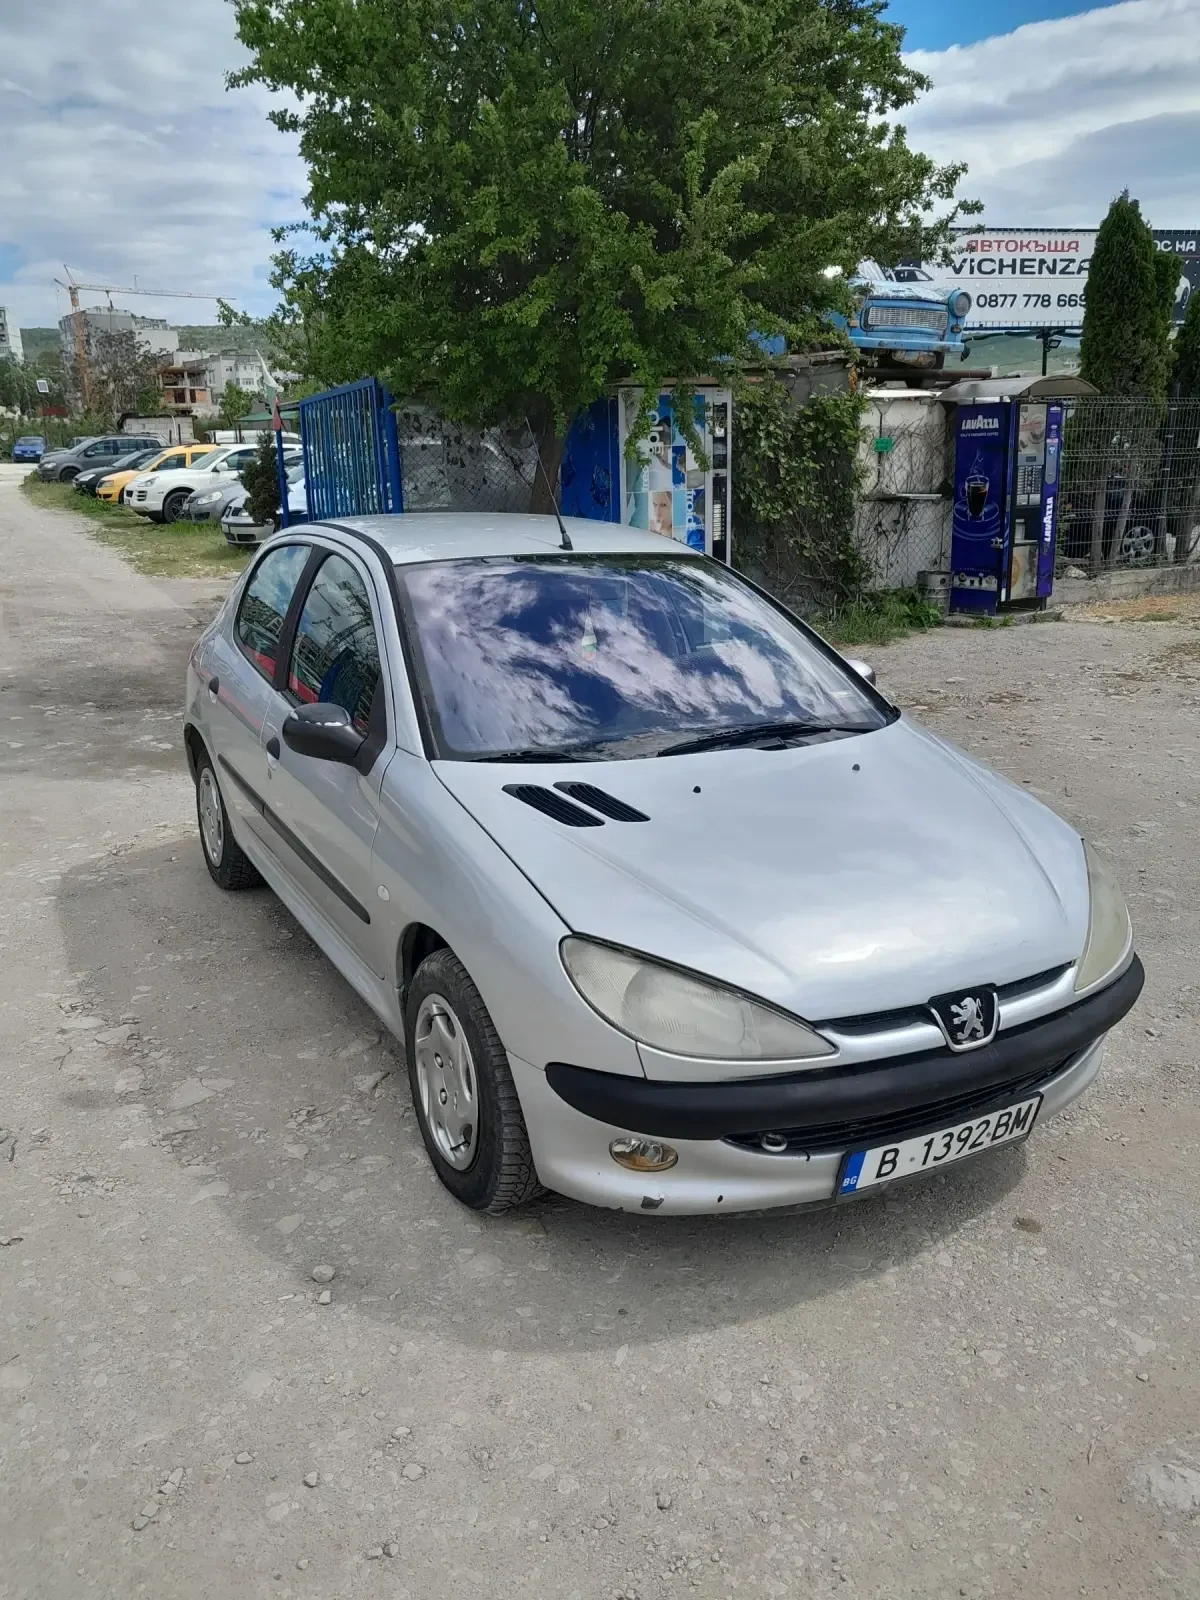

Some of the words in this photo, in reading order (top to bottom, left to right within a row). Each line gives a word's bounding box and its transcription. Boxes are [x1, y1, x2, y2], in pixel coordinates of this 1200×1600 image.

[1175, 240, 1196, 252] НА
[976, 294, 1017, 308] 0877
[1022, 294, 1051, 308] 778
[961, 414, 1000, 430] LAVAZZA
[1043, 496, 1054, 542] LAVAZZA
[875, 1148, 900, 1178] B
[921, 1119, 991, 1166] 1392
[990, 1102, 1033, 1142] BM
[842, 1176, 857, 1187] BG
